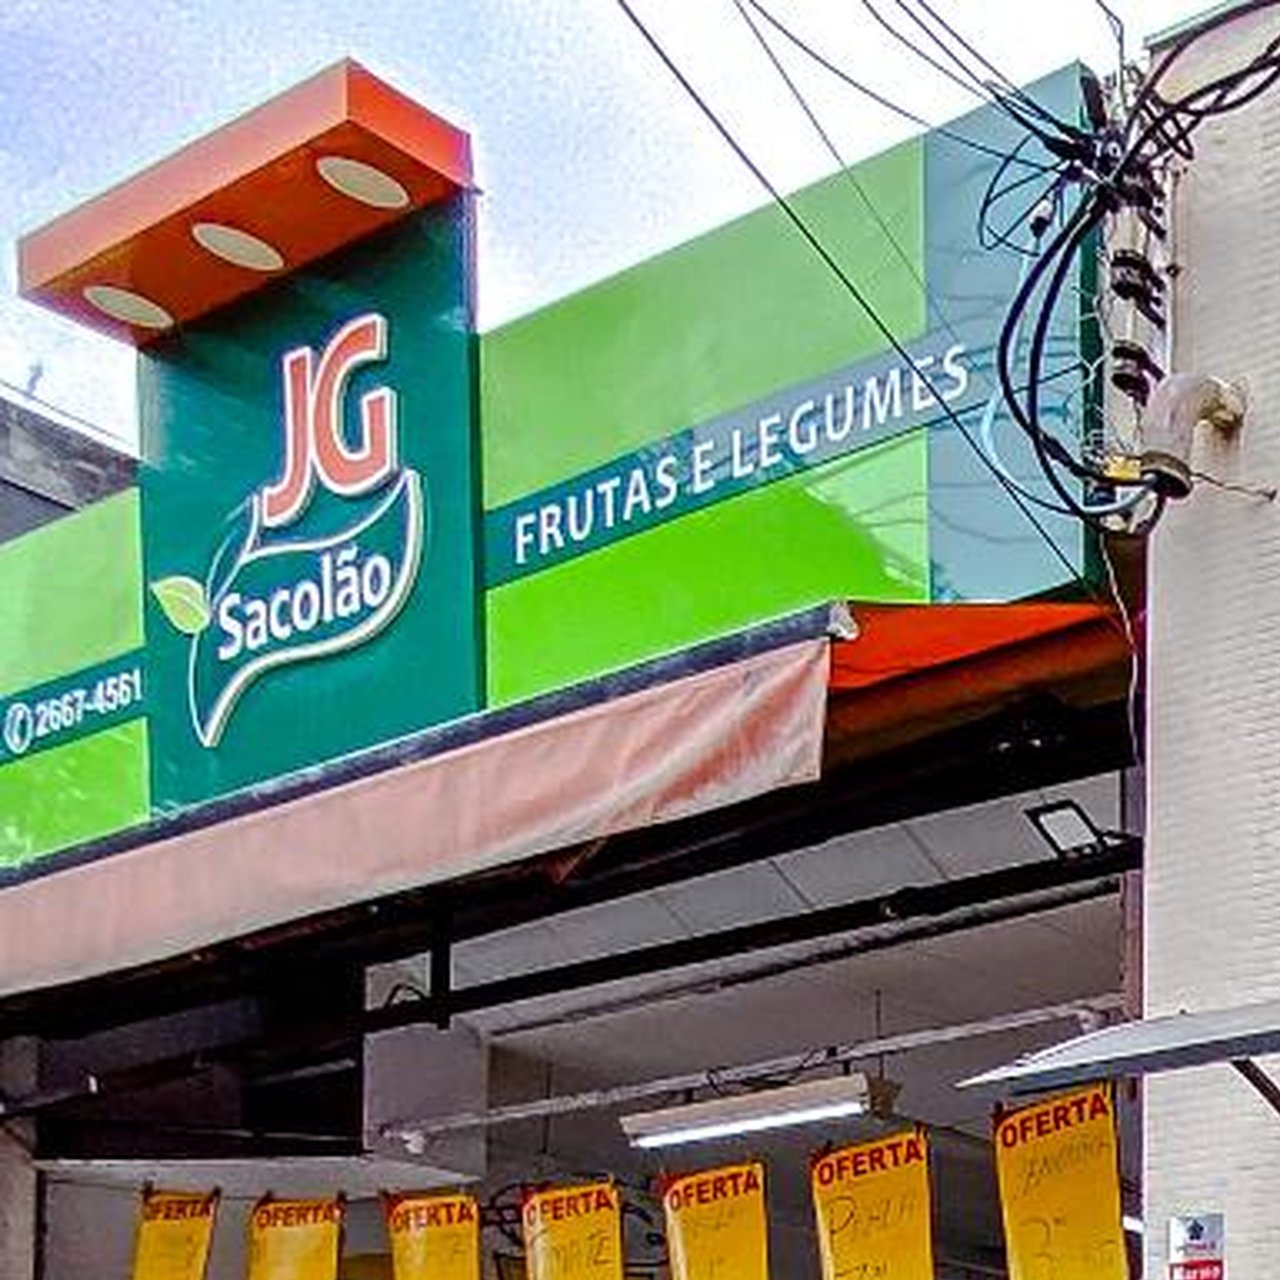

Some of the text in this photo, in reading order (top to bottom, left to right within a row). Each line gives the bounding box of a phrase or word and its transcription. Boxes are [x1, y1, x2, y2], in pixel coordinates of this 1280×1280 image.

[262, 312, 398, 532] JG
[514, 344, 969, 564] FRUTAS E LEGUMES
[217, 544, 391, 659] Sacolão
[34, 667, 143, 739] 2667-4561
[1001, 1093, 1110, 1148] OFERTA
[818, 1140, 923, 1185] OFERTA
[255, 1203, 340, 1229] OFERTA
[526, 1189, 614, 1226] OFERTA
[669, 1171, 760, 1212] OFERTA
[392, 1202, 474, 1232] OFERTA
